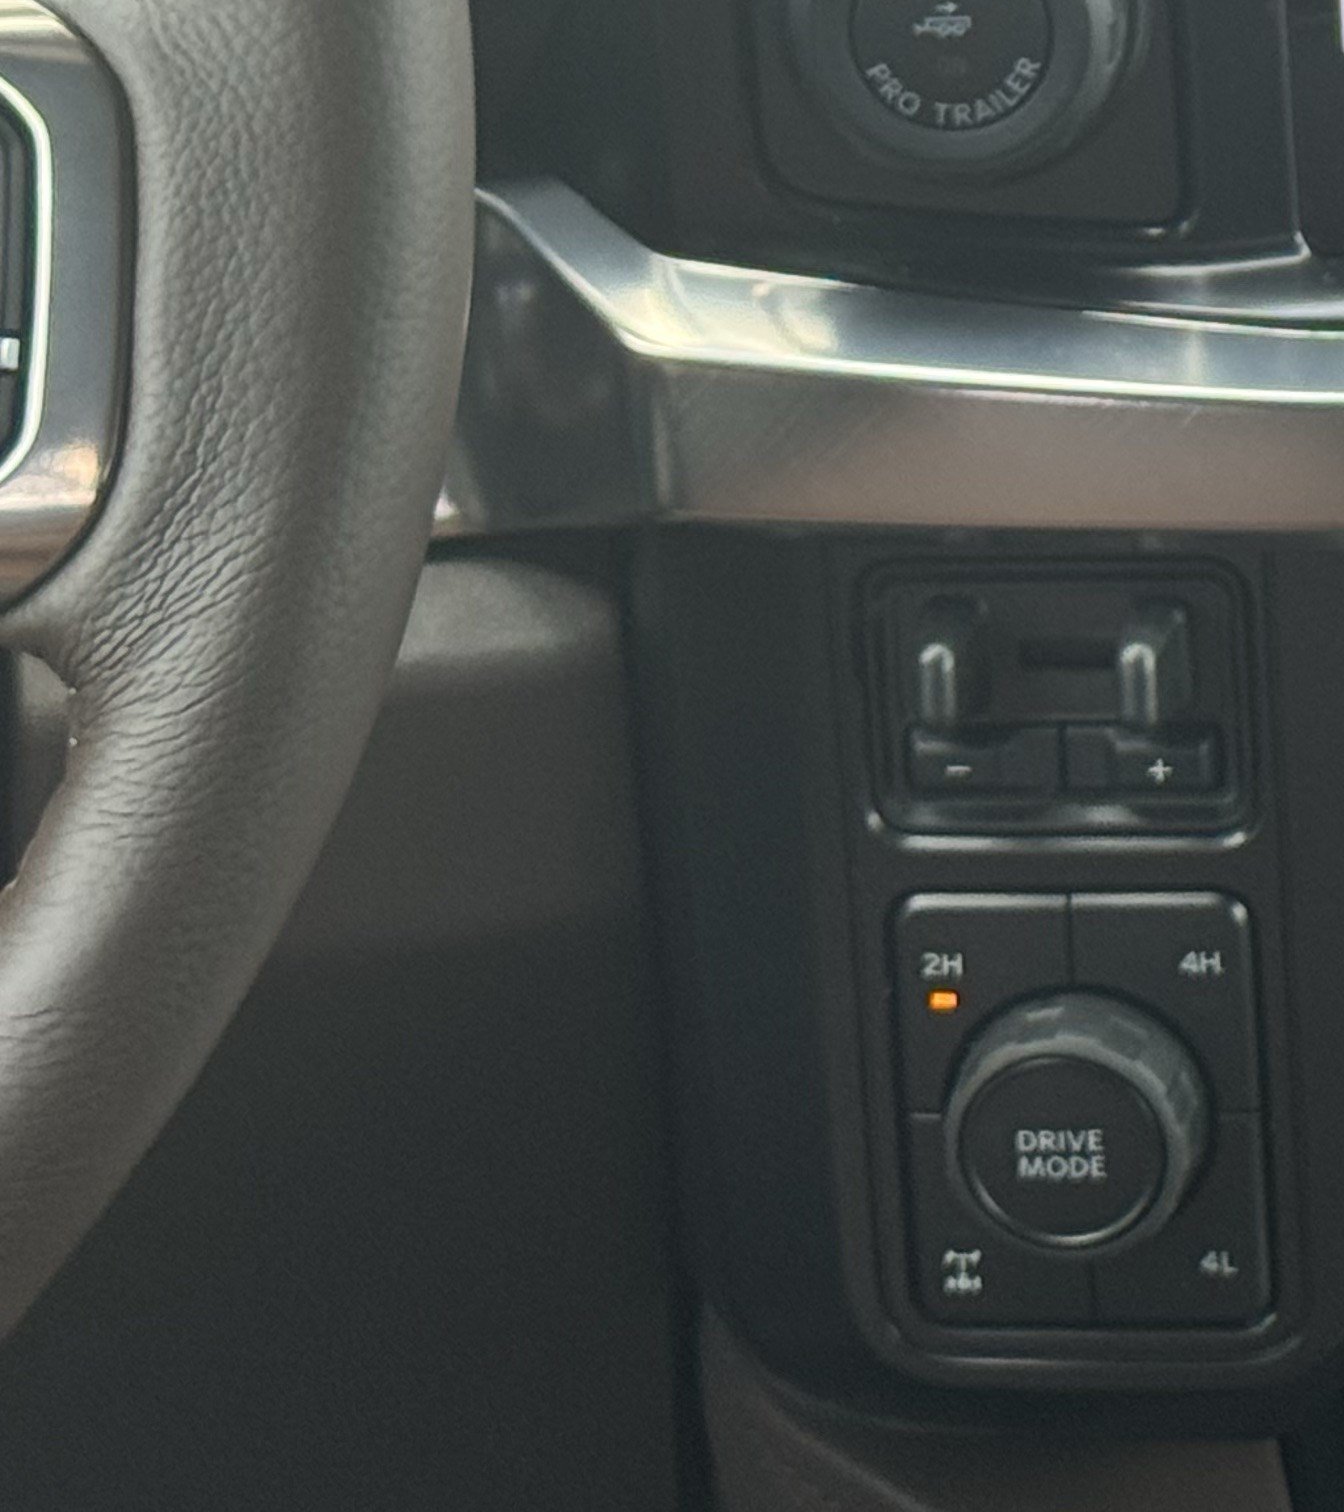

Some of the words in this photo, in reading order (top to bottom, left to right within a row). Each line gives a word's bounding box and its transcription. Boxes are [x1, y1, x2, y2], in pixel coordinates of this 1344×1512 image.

[865, 61, 922, 119] PRO
[933, 55, 1043, 126] TRAILER
[920, 951, 965, 980] 2H
[1177, 949, 1225, 977] 4H
[1015, 1128, 1106, 1153] DRIVE
[1016, 1154, 1108, 1181] MODE
[1200, 1249, 1240, 1276] 4L
